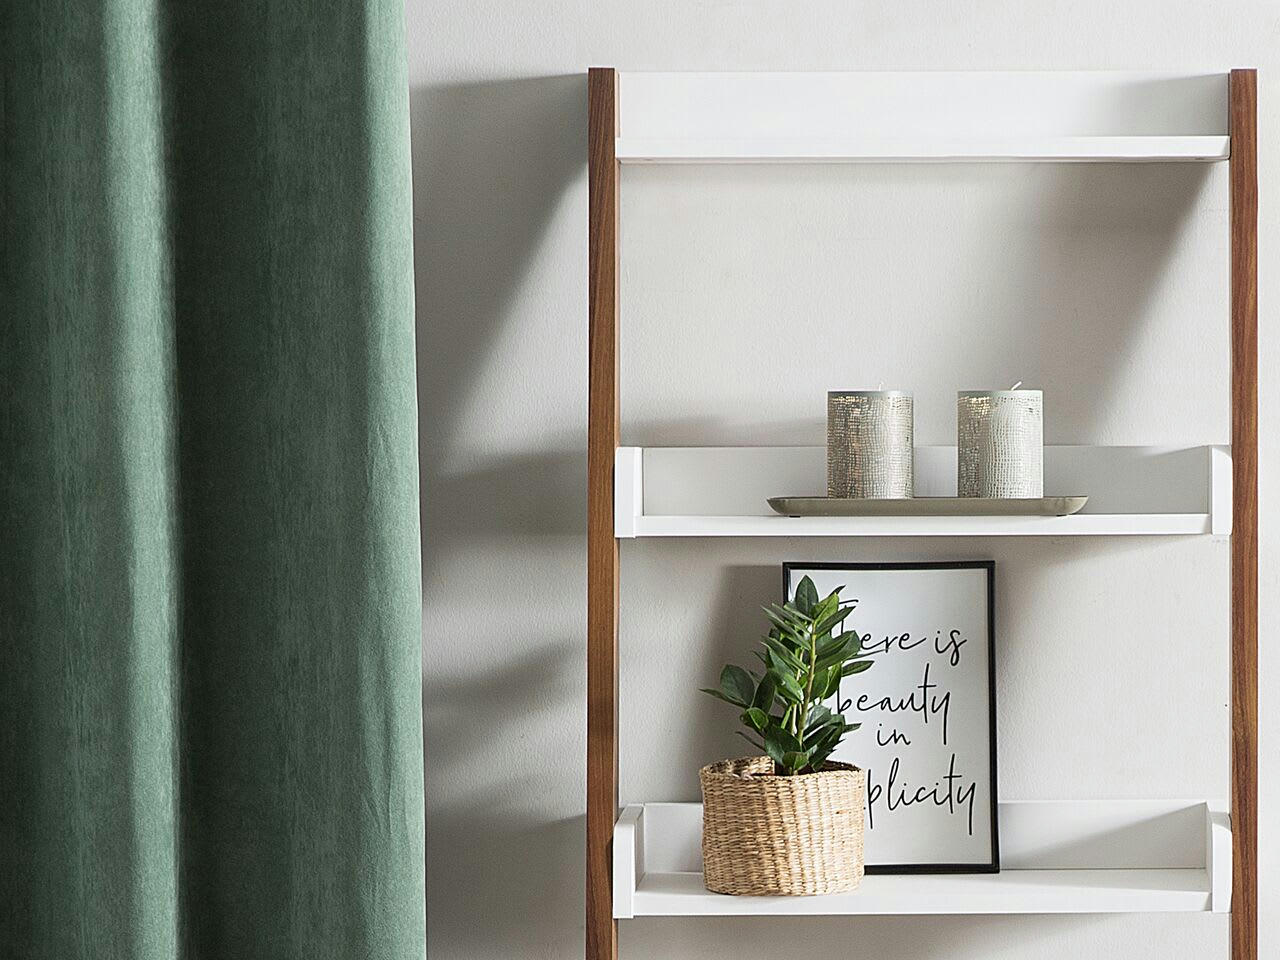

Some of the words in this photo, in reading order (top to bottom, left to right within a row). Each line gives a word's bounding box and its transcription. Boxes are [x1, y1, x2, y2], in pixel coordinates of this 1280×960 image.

[829, 599, 927, 653] ere
[934, 629, 967, 667] is
[836, 662, 951, 746] beauty
[876, 723, 912, 746] in
[863, 753, 976, 836] plicity
